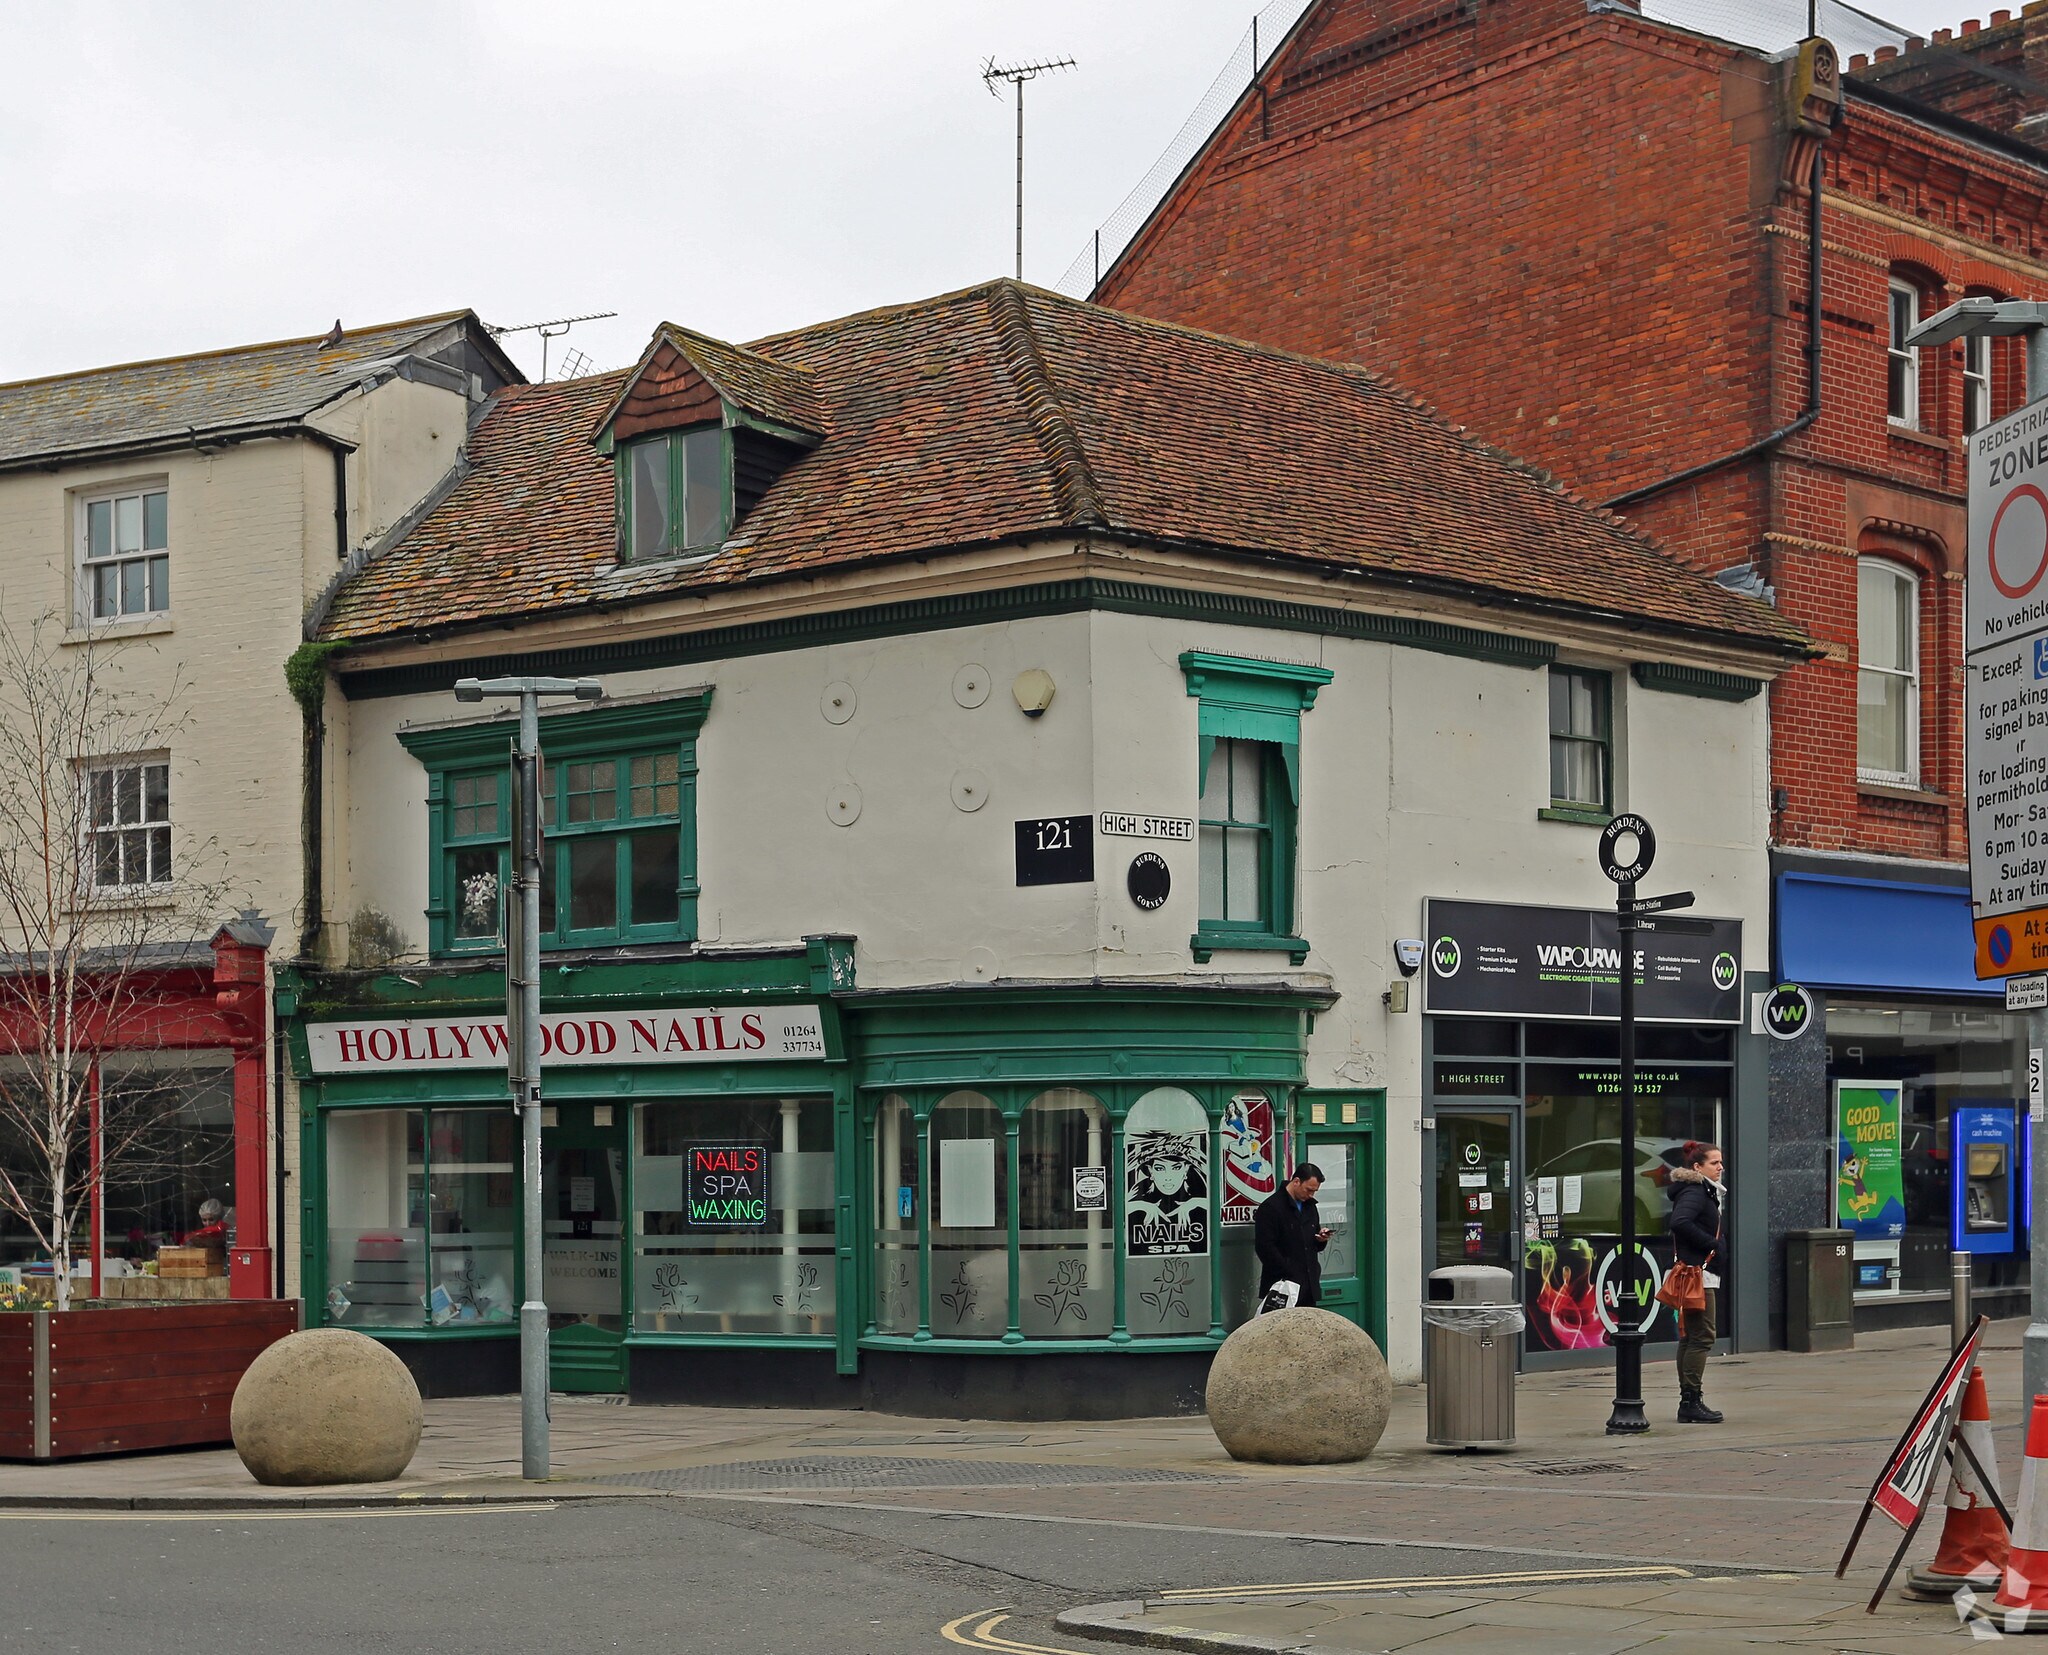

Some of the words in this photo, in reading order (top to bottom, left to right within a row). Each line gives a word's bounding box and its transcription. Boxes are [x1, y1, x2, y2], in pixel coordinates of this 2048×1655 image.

[1989, 433, 2048, 488] ZONE
[1985, 617, 2003, 636] No
[1979, 703, 1997, 720] for
[1978, 769, 1997, 786] for
[2001, 757, 2046, 781] loading
[1104, 814, 1136, 833] HIGH
[1143, 818, 1191, 837] STREET
[1606, 816, 1646, 838] BURDENS
[1036, 819, 1073, 851] i2i
[1135, 853, 1165, 870] BURDENS
[1608, 863, 1644, 881] CORNER
[1137, 894, 1164, 909] CORNER
[1988, 887, 2003, 905] At
[1632, 902, 1646, 912] Police
[1646, 900, 1661, 910] Station
[1637, 919, 1656, 931] Library
[2023, 920, 2040, 938] At
[1480, 945, 1496, 953] Starter
[1496, 946, 1506, 954] Kits
[1479, 955, 1499, 963] Premium
[1499, 956, 1518, 964] E-Liquid
[1479, 965, 1504, 973] Mechanical
[1504, 966, 1516, 974] Mods
[1665, 966, 1681, 974] Building
[1540, 974, 1572, 982] ELECTRONIC
[1657, 974, 1681, 982] Accessories
[2009, 983, 2019, 993] No
[2020, 981, 2045, 992] loading
[2008, 996, 2015, 1005] at
[2016, 995, 2029, 1005] any
[2030, 993, 2045, 1002] time
[627, 1013, 767, 1053] NAILS
[783, 1024, 817, 1038] 01264
[782, 1040, 822, 1054] 337734
[1441, 1075, 1446, 1083] 1
[1449, 1075, 1471, 1083] HIGH
[1474, 1075, 1506, 1084] STREET
[2030, 1077, 2040, 1093] 2
[1646, 1084, 1662, 1093] 527
[1846, 1105, 1881, 1126] GOOD
[1856, 1121, 1896, 1144] MOVE!
[1971, 1129, 1982, 1137] cash
[1983, 1129, 2002, 1137] machine
[695, 1150, 759, 1172] NAILS
[703, 1175, 752, 1196] SPA
[691, 1199, 764, 1220] WAXING
[1469, 1199, 1478, 1208] 18
[1220, 1206, 1252, 1222] NAILS
[1133, 1222, 1204, 1244] NAILS
[549, 1251, 618, 1262] WALK-INS
[1148, 1244, 1191, 1254] SPA
[1835, 1245, 1847, 1256] 58
[549, 1267, 618, 1278] WELCOME
